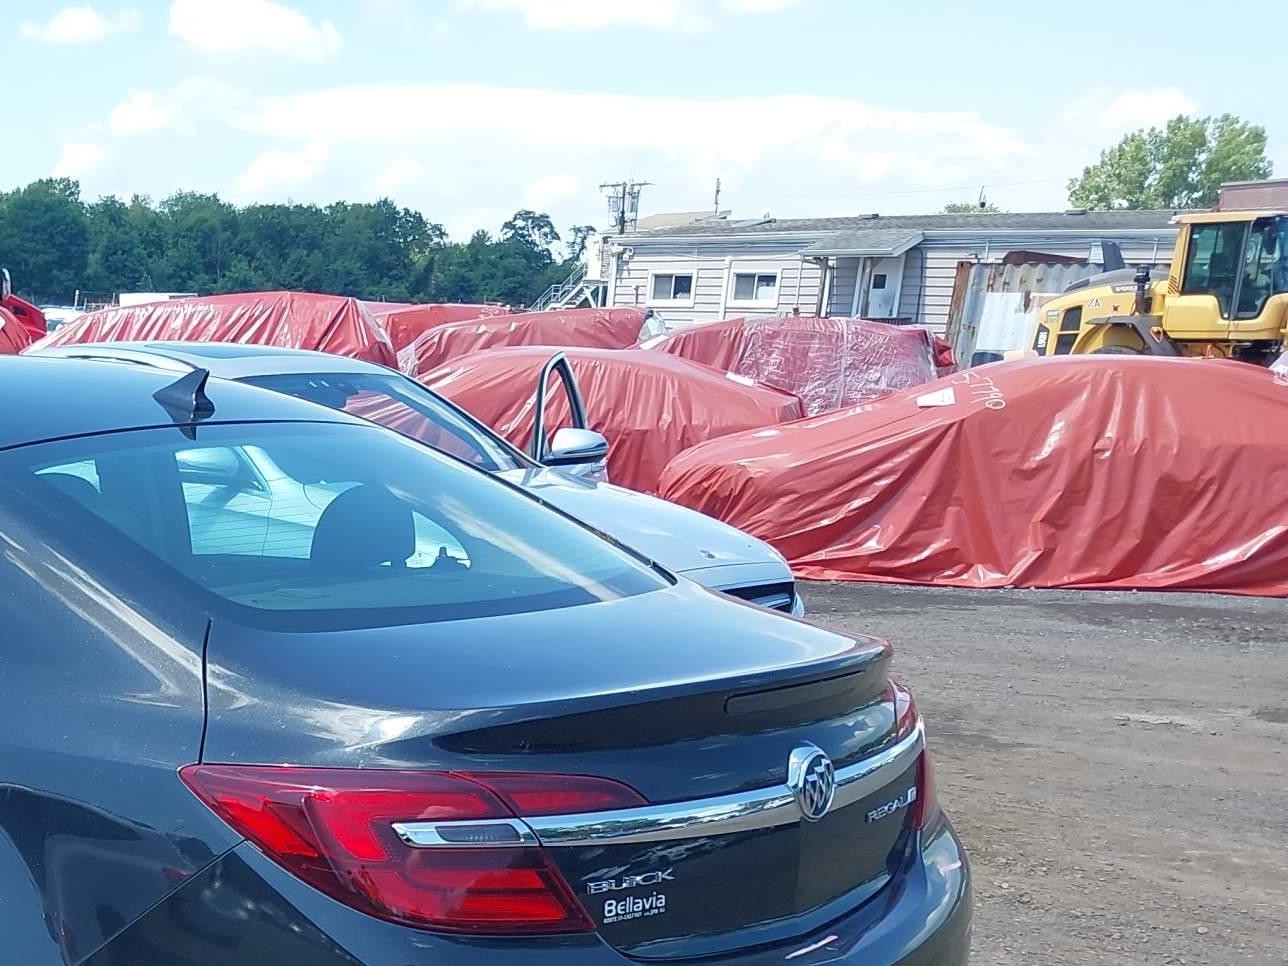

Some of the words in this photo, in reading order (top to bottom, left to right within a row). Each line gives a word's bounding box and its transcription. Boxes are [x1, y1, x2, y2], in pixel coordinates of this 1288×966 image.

[865, 796, 909, 822] REGAL
[586, 867, 675, 895] BUICK
[604, 891, 666, 917] Bellavia
